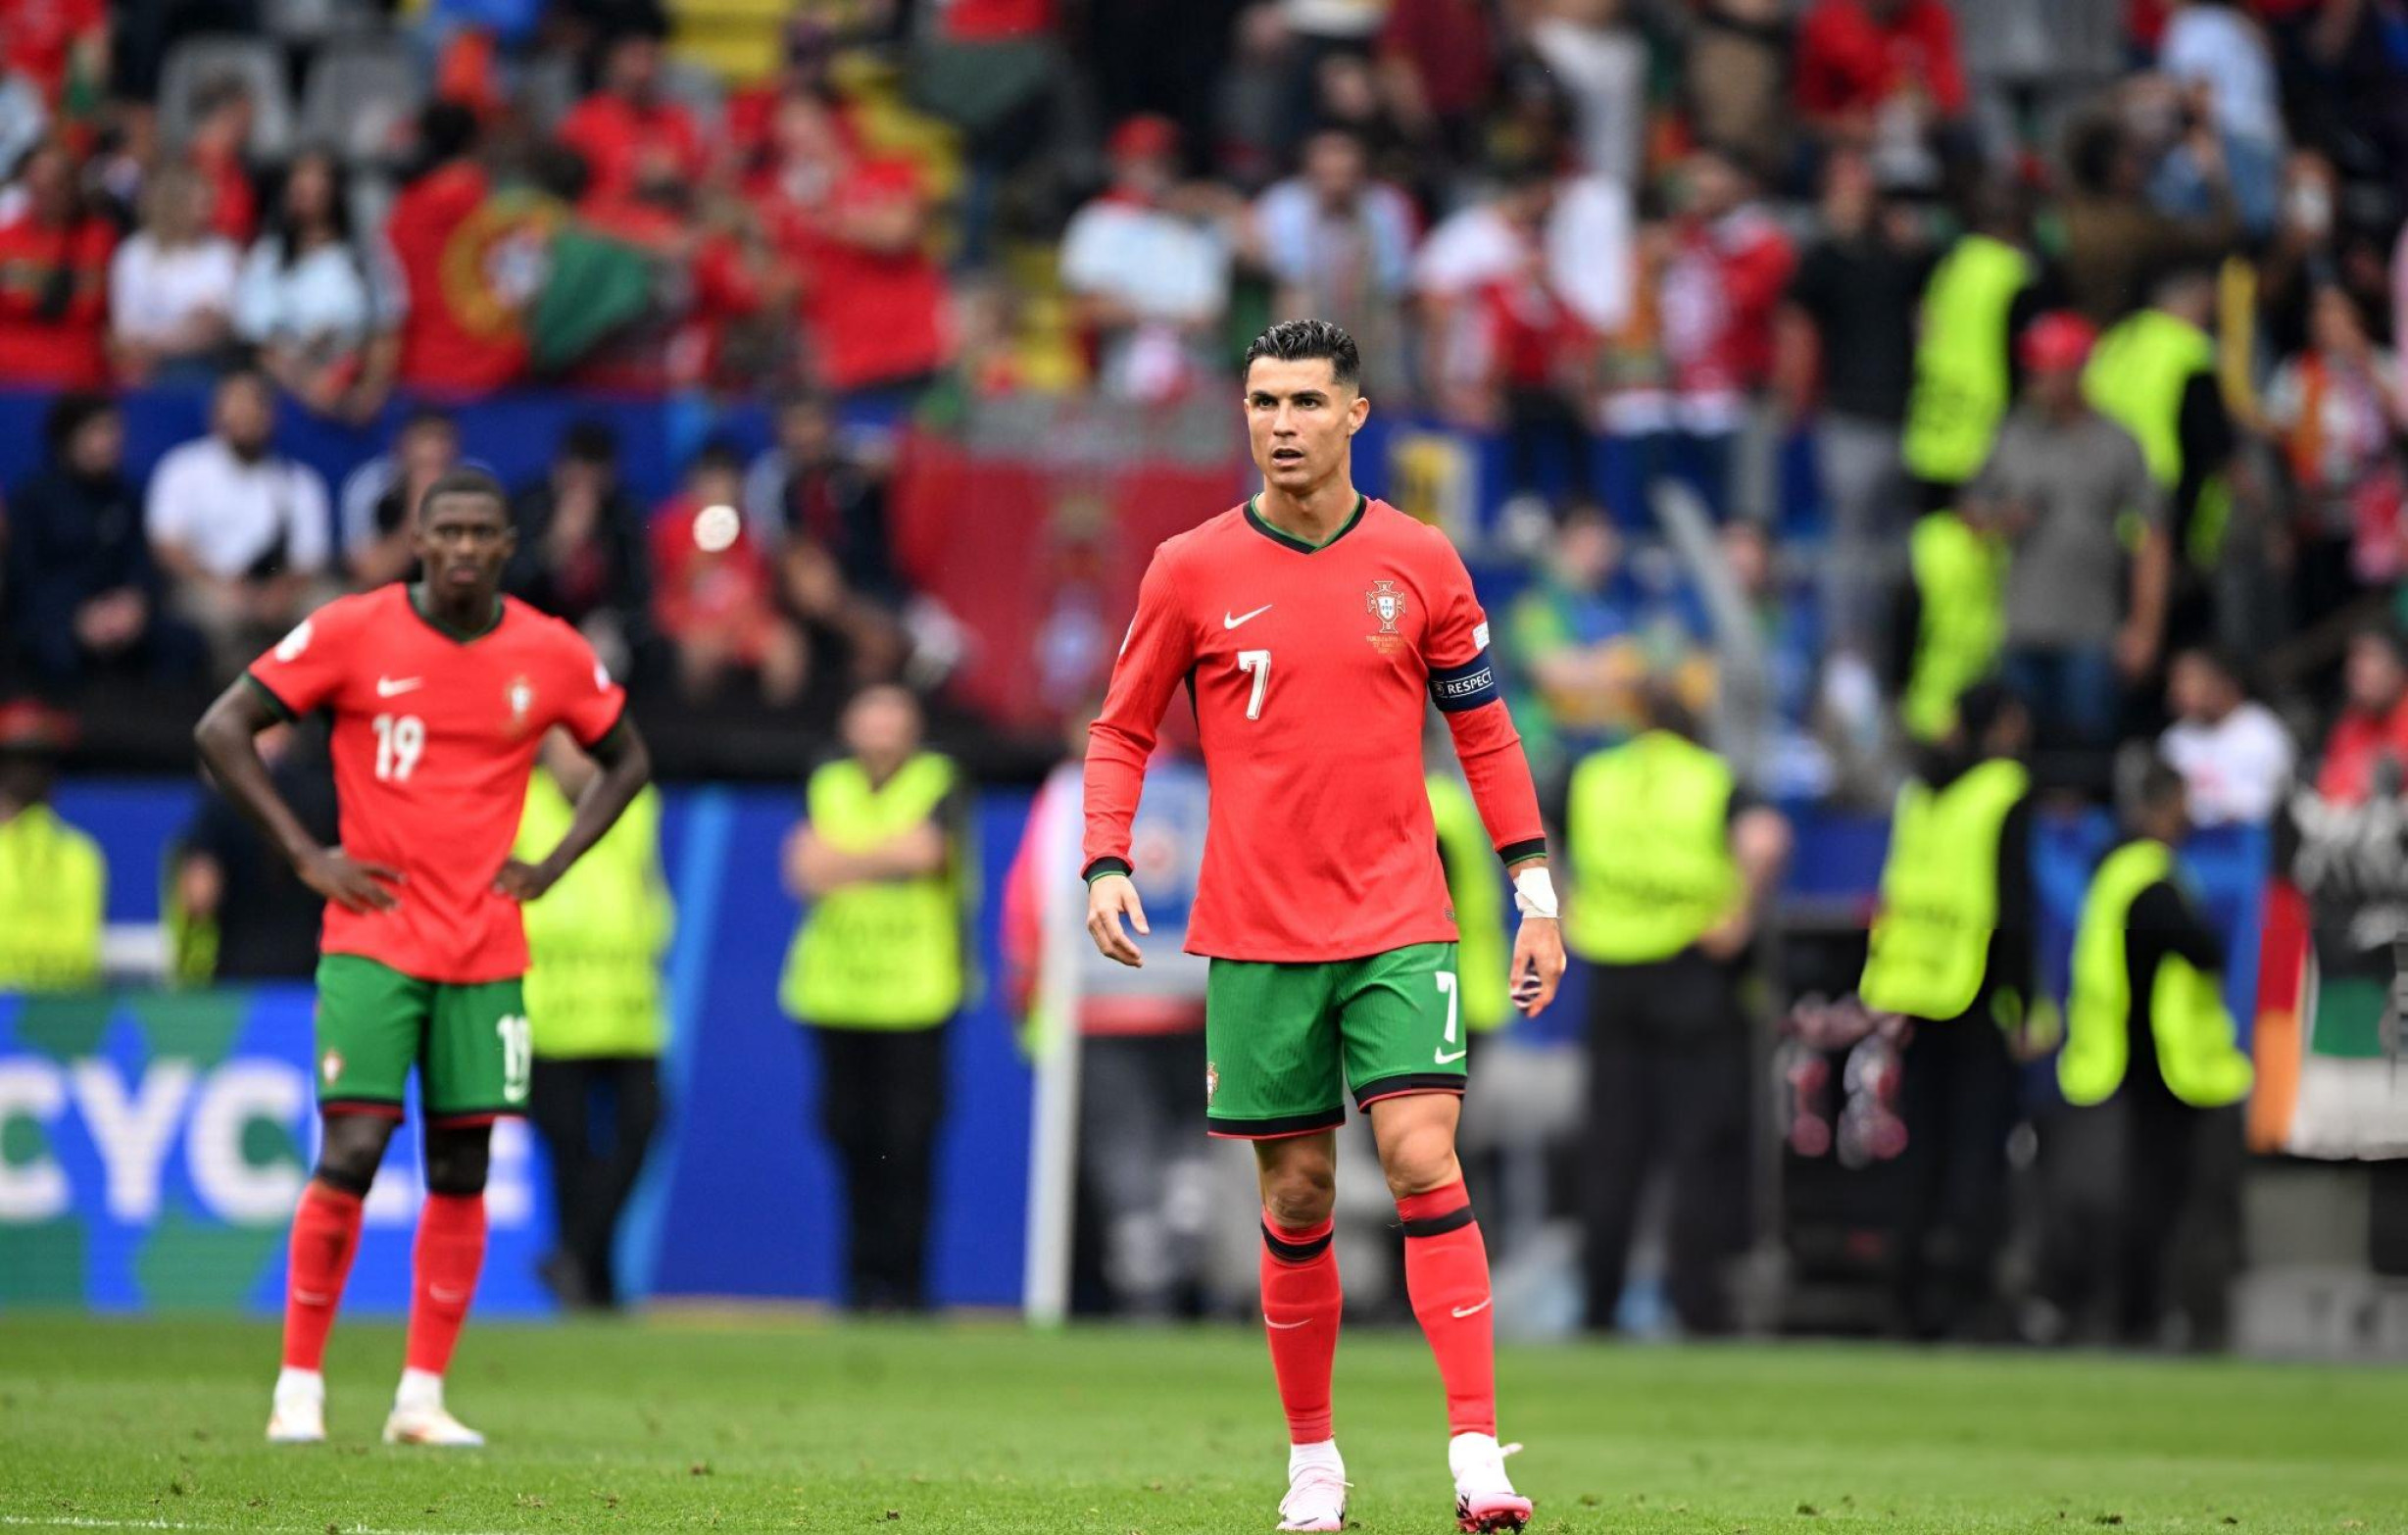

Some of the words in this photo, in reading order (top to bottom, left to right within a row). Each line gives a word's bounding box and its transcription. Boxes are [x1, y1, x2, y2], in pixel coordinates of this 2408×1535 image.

[1238, 649, 1272, 720] 7
[1447, 670, 1494, 695] RESPECT
[372, 713, 425, 782] 19
[1434, 970, 1459, 1045] 7
